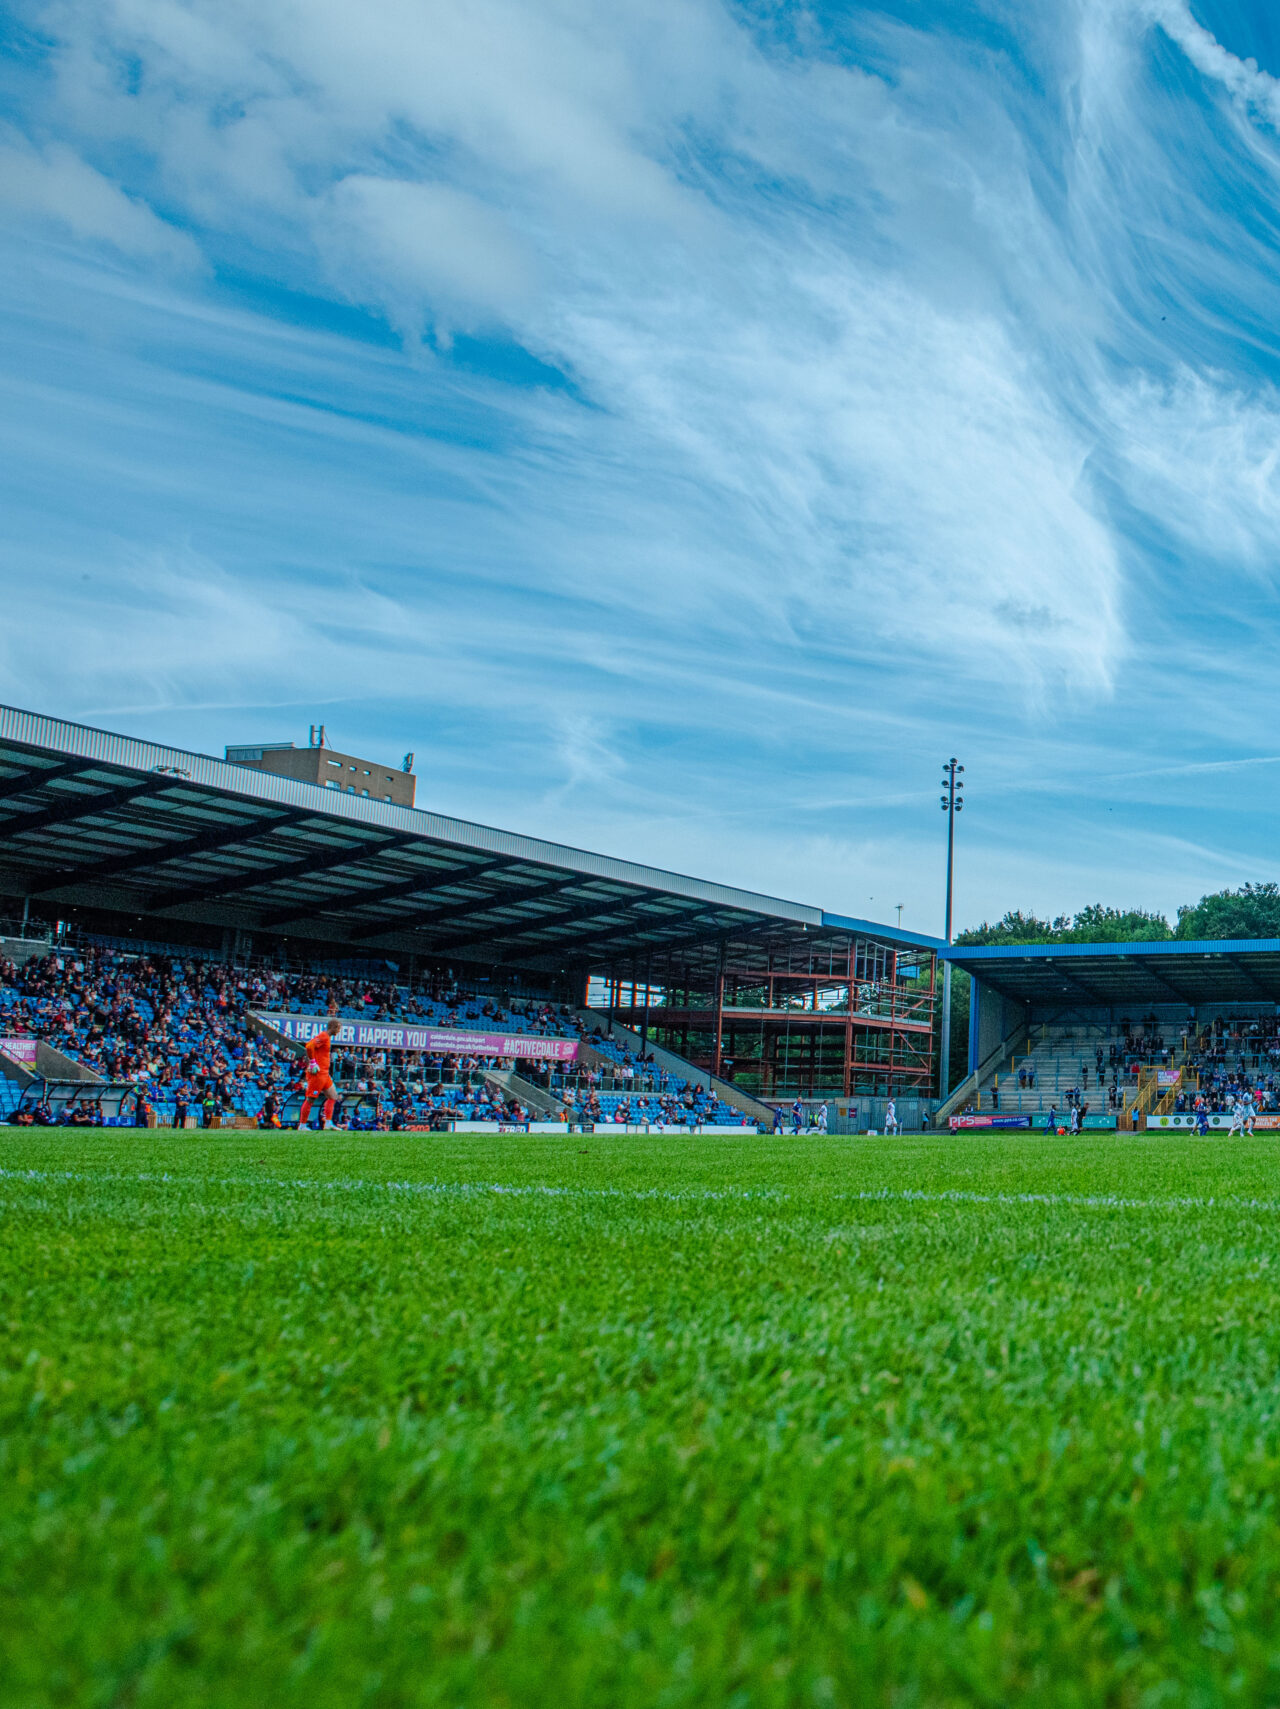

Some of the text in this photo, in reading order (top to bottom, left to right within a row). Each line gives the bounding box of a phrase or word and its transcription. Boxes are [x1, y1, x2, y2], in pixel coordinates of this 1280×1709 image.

[284, 1021, 293, 1039] A
[296, 1021, 355, 1042] HEALIER
[359, 1026, 404, 1045] HAPPIER
[406, 1031, 427, 1048] YOU
[504, 1039, 560, 1057] #ACTIVECDALE
